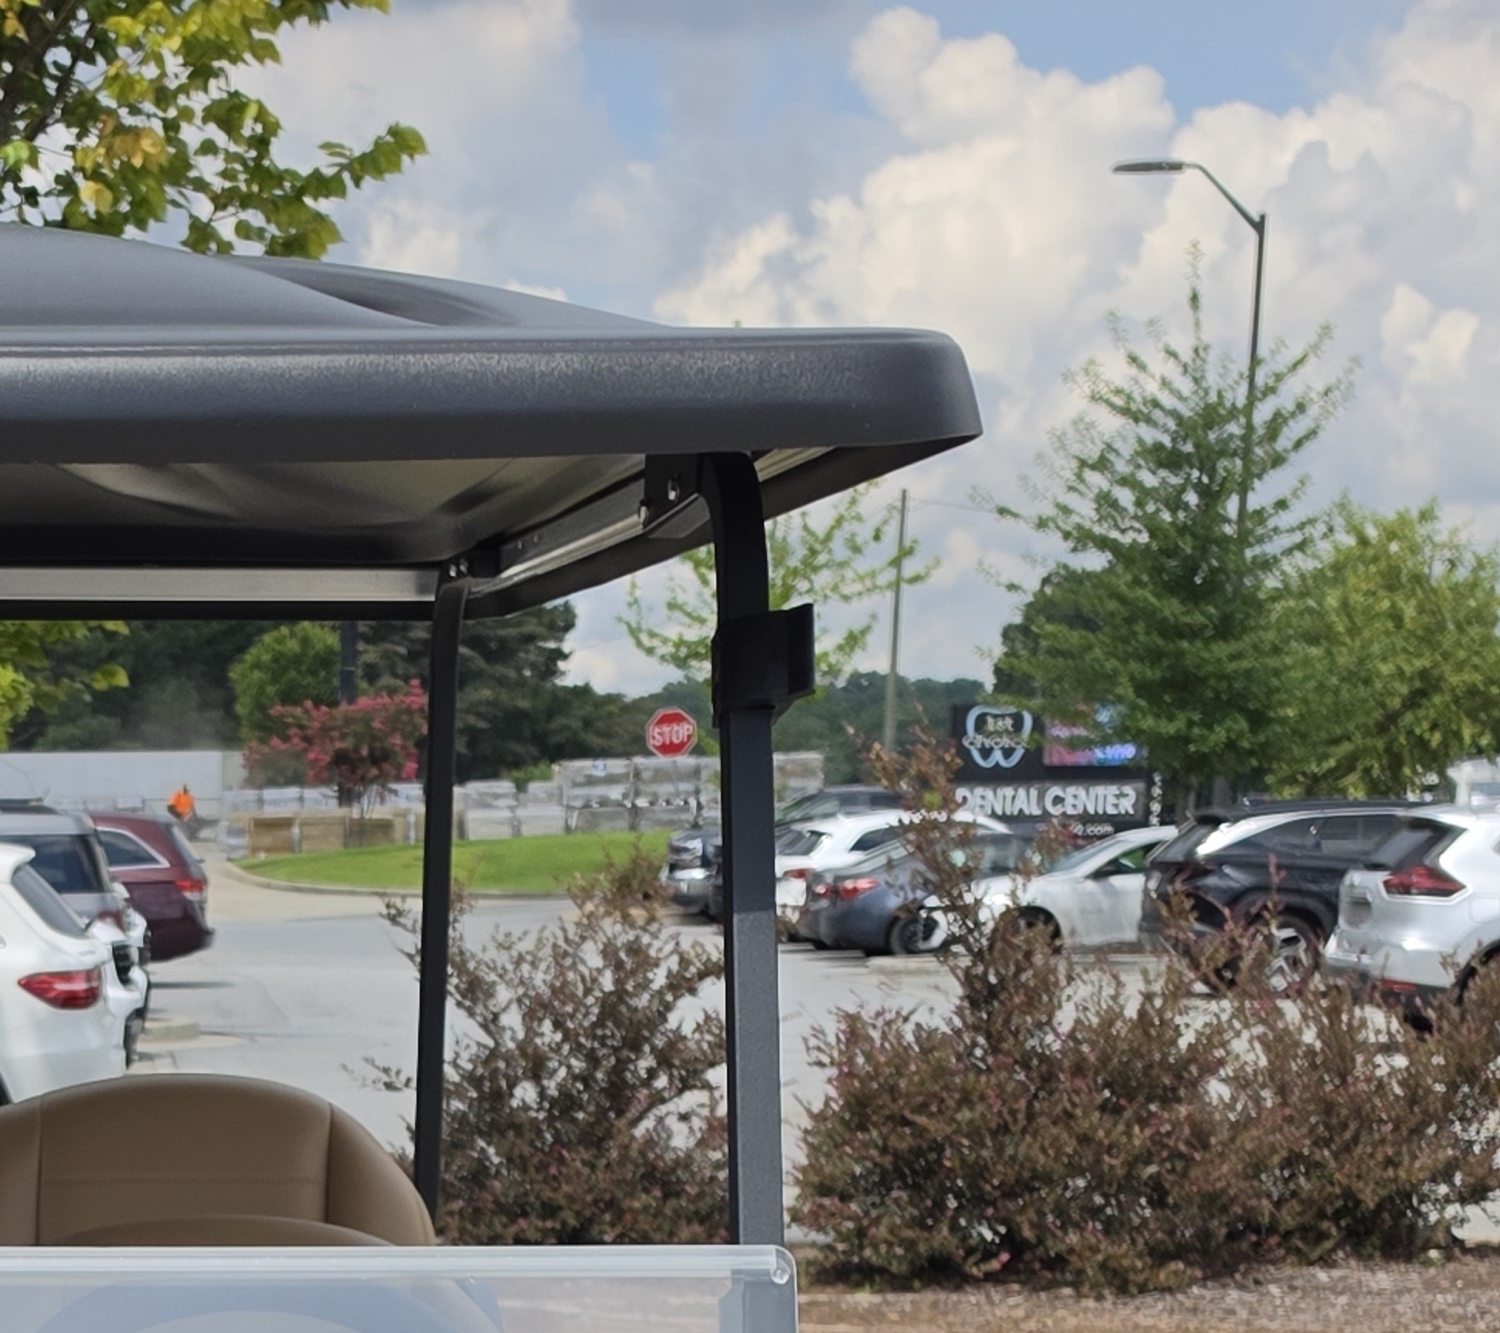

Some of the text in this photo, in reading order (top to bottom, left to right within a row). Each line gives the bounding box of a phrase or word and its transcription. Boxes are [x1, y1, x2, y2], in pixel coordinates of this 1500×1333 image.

[651, 722, 693, 747] STOP
[954, 785, 1043, 817] DENTAL
[1044, 785, 1137, 817] CENTER
